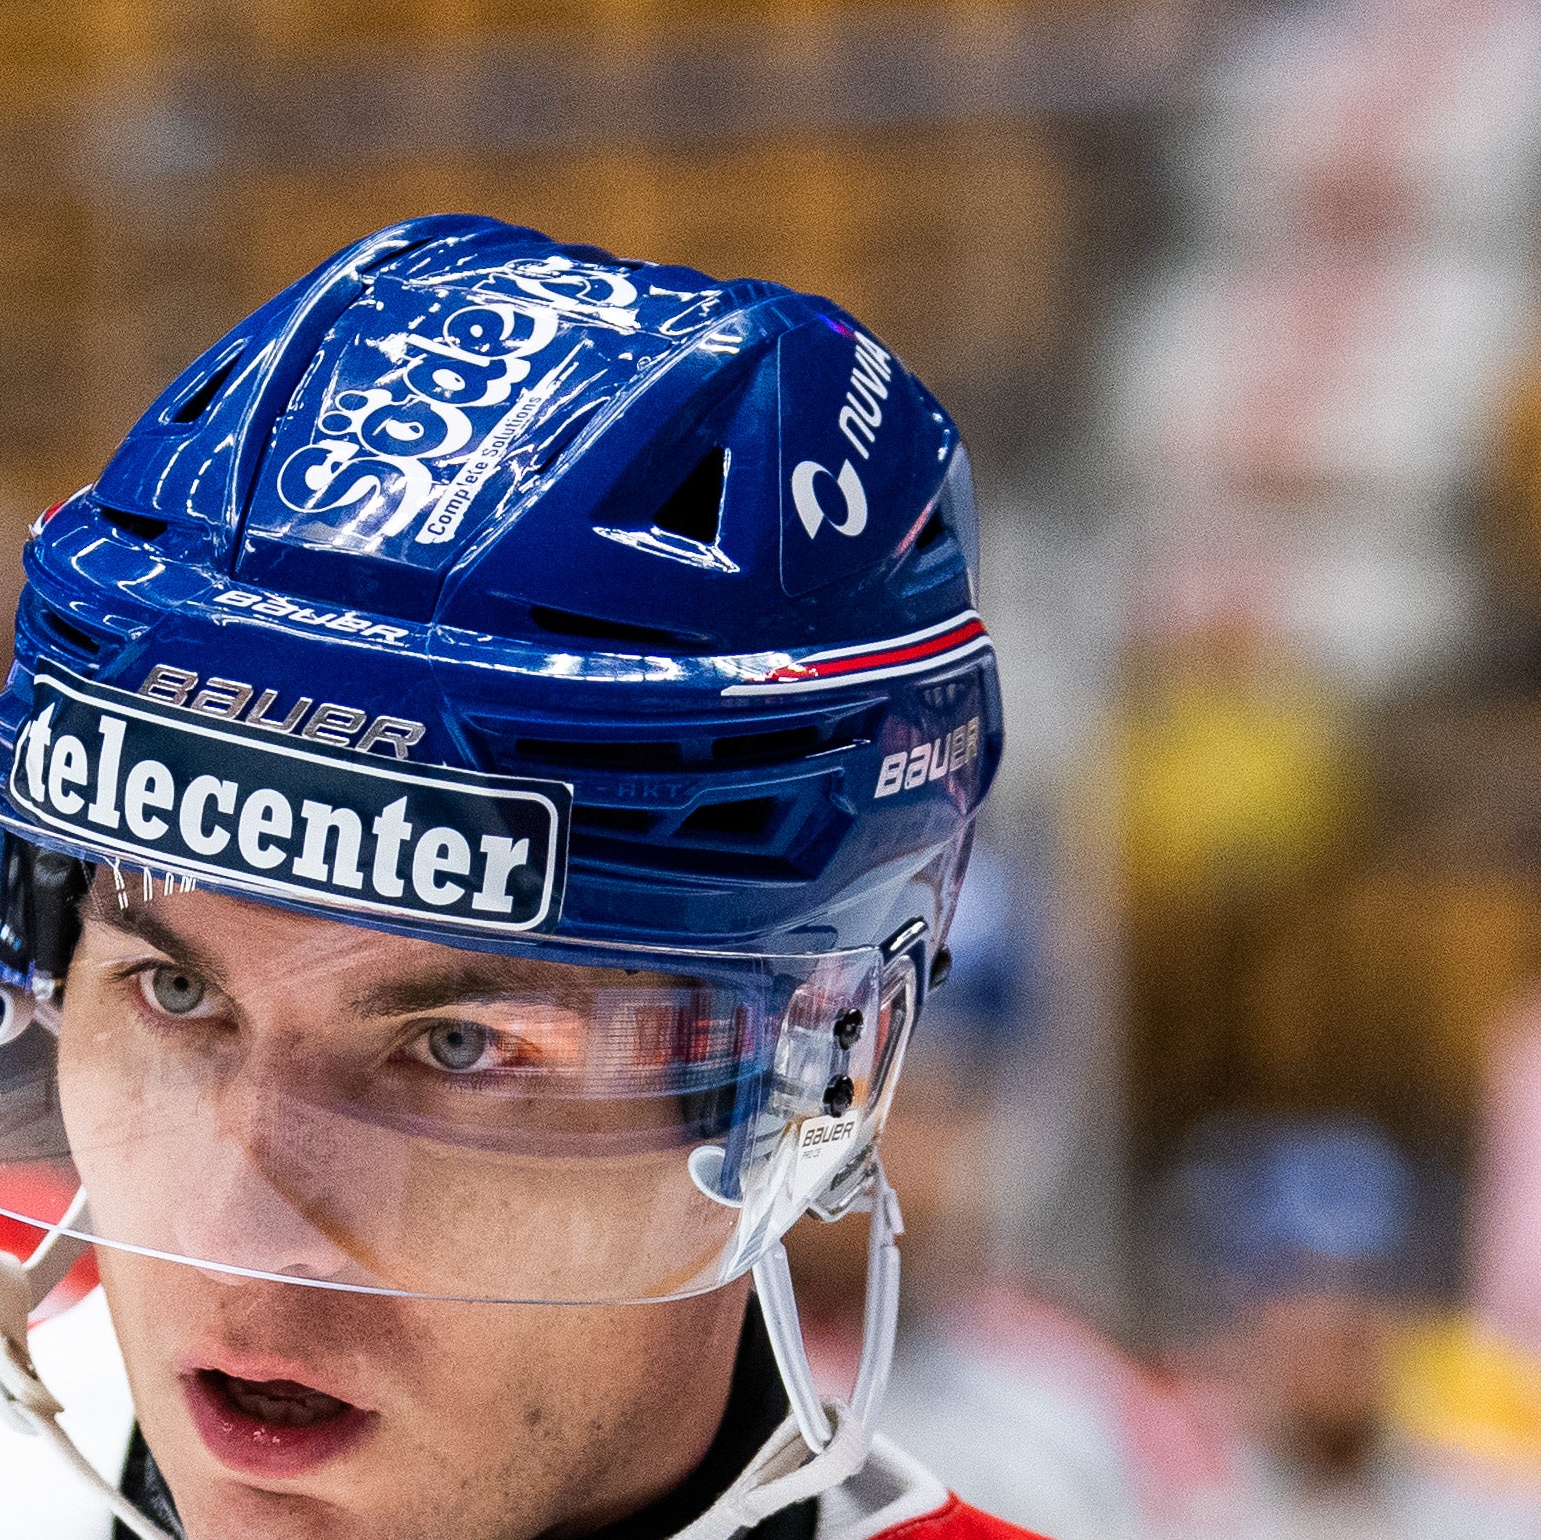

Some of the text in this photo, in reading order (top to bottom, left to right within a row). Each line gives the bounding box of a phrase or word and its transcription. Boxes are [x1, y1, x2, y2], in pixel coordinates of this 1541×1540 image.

[427, 395, 542, 537] Complete Solutions
[137, 664, 426, 760] BAUER
[23, 702, 531, 913] telecenter
